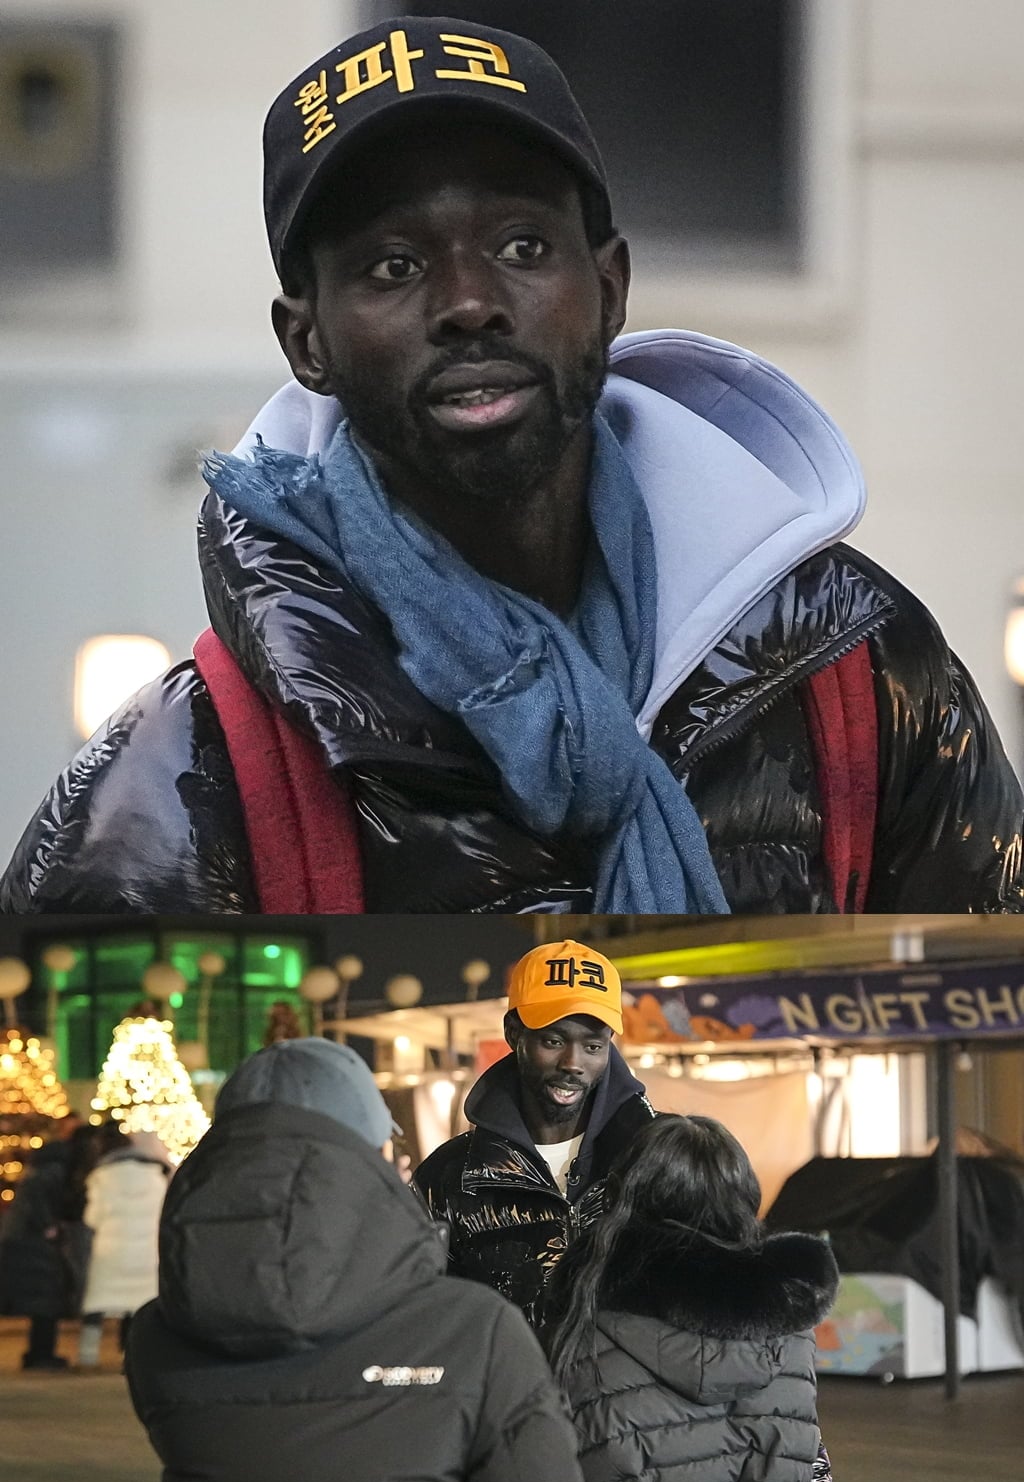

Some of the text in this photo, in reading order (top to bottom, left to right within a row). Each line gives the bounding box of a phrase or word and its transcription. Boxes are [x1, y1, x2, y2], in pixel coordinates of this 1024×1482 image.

[335, 30, 528, 104] 파코
[293, 69, 337, 153] 원조
[544, 957, 608, 992] 파코
[779, 986, 1024, 1035] N GIFT SH
